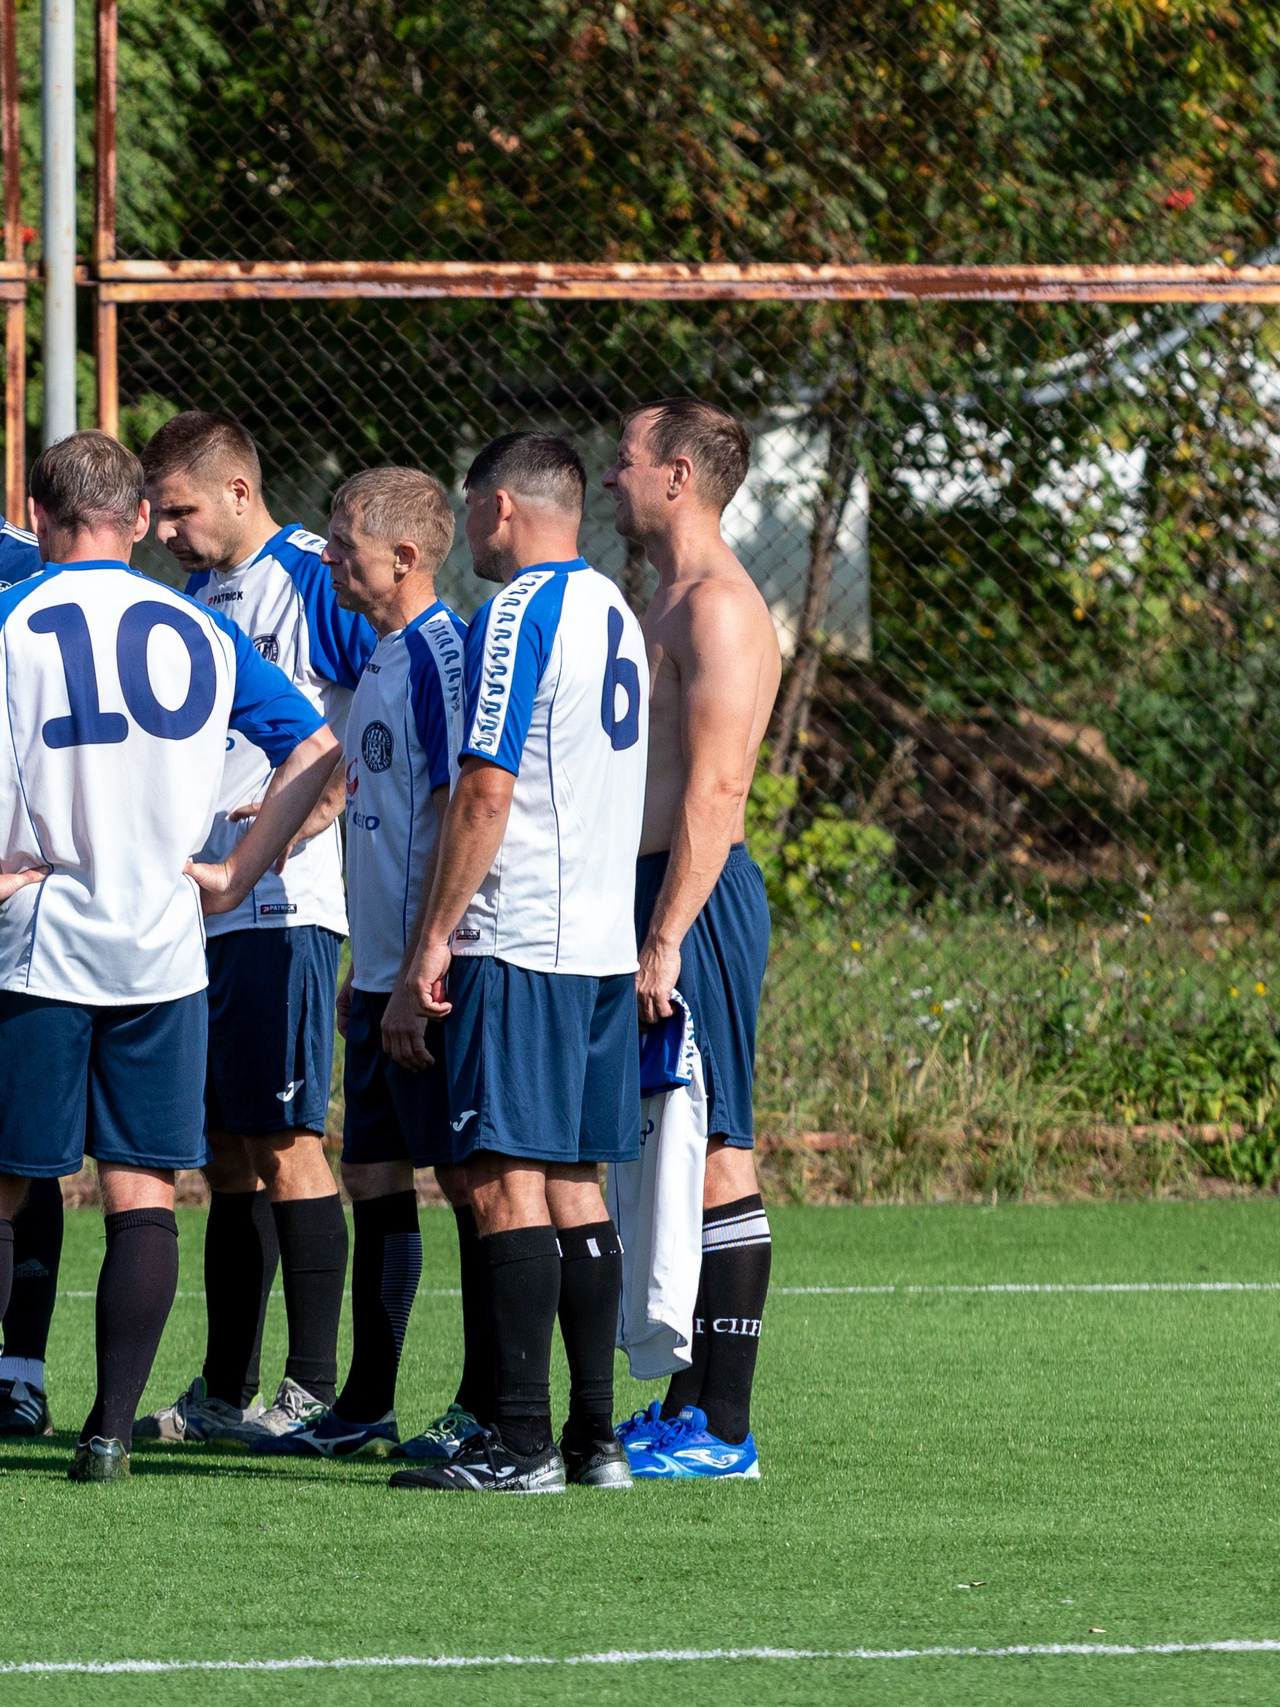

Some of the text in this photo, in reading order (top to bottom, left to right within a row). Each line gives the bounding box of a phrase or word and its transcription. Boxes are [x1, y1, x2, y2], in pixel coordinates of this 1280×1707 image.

[212, 591, 244, 605] PATRICK
[27, 600, 217, 749] 10
[601, 606, 640, 751] 6
